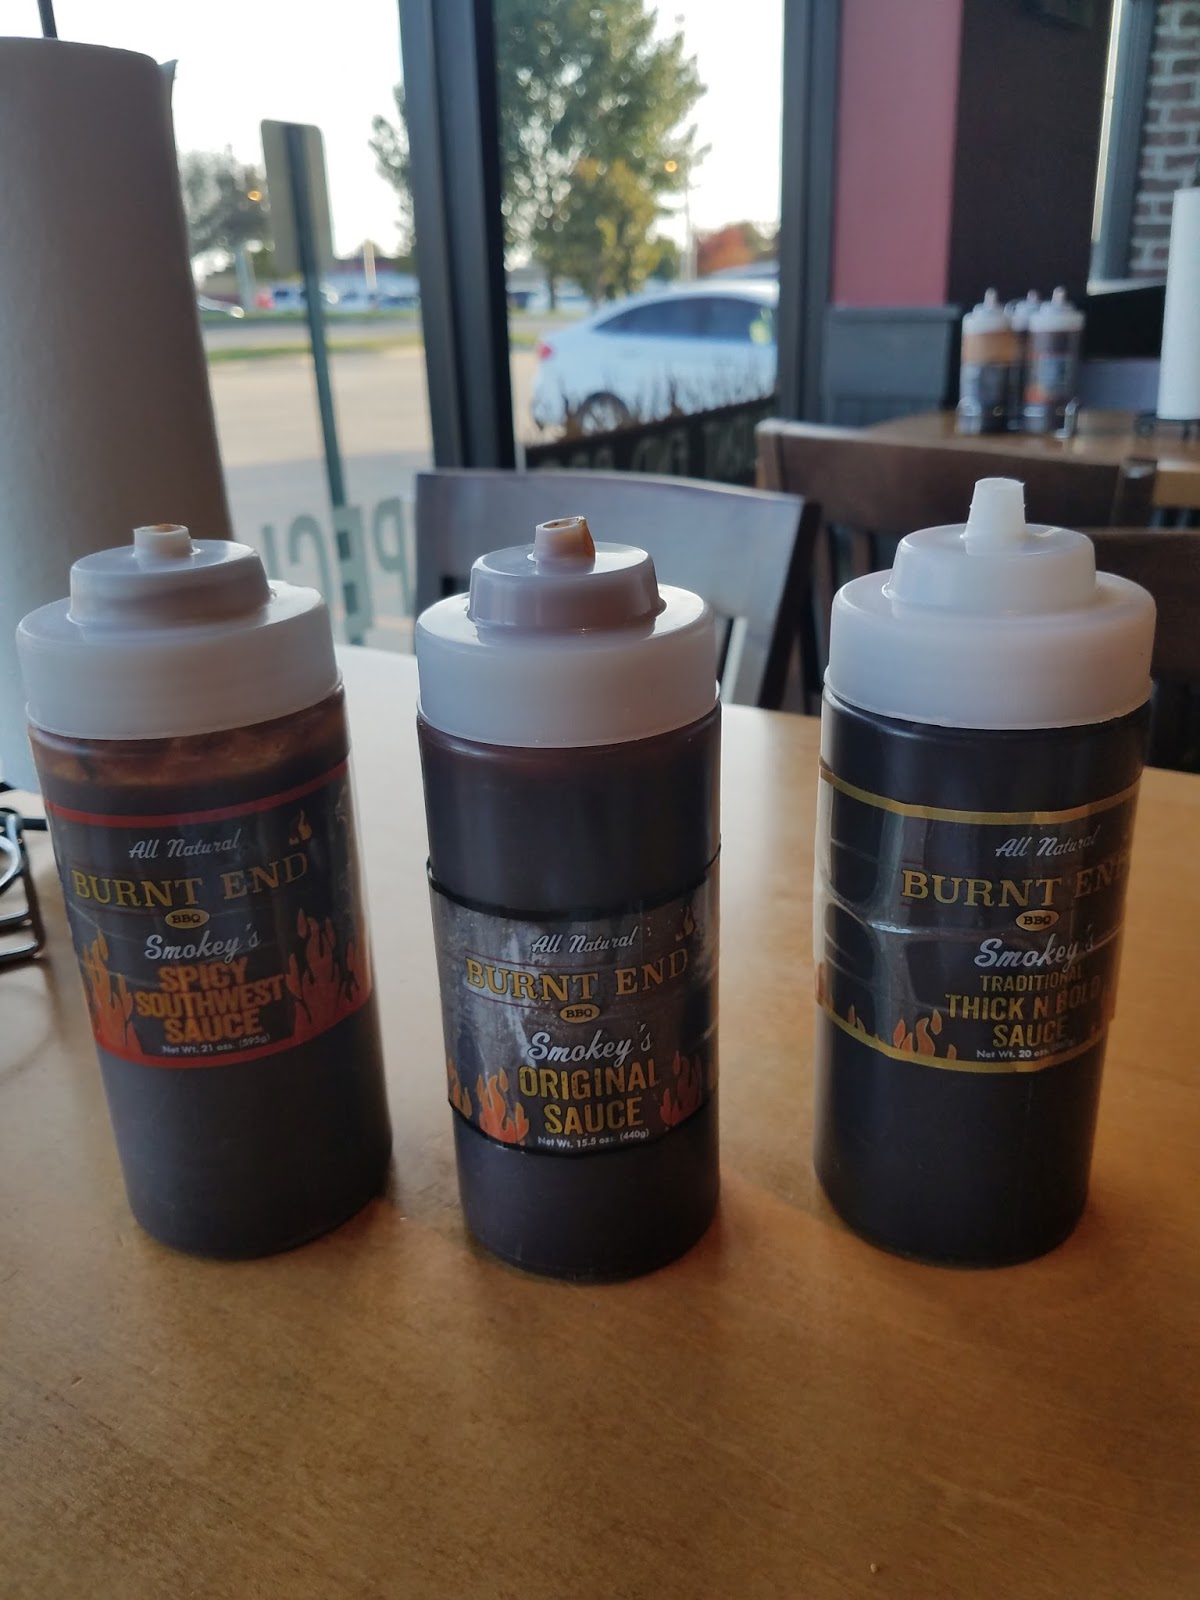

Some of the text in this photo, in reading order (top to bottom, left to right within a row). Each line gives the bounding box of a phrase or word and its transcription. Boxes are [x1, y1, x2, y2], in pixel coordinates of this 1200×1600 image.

[128, 828, 242, 859] All Natural
[994, 824, 1101, 857] All Natural
[71, 852, 308, 907] BURNT END
[901, 869, 1062, 907] BURNT
[171, 913, 201, 925] BBQ
[1023, 915, 1052, 925] BBQ
[144, 923, 262, 963] Smokey's
[531, 926, 639, 953] All Natural
[158, 957, 248, 993] SPICY
[465, 949, 689, 1002] BURNT END
[979, 965, 1083, 992] TRADITIONAL
[134, 974, 285, 1018] SOUTHWEST
[945, 993, 1025, 1021] THICK
[1033, 995, 1048, 1020] N
[164, 1008, 263, 1044] SAUCE
[566, 1008, 592, 1019] BBQ
[528, 1022, 652, 1068] Smokey's
[992, 1015, 1069, 1048] SAUCE
[182, 1045, 198, 1053] Wt.
[202, 1044, 213, 1052] 21
[976, 1050, 995, 1058] Net
[999, 1050, 1016, 1058] Wt.
[1018, 1050, 1032, 1058] 20
[518, 1060, 659, 1100] ORIGINAL
[543, 1096, 644, 1136] SAUCE
[538, 1136, 554, 1146] Net
[557, 1138, 574, 1148] Wt.
[577, 1137, 596, 1148] 15.5
[619, 1128, 649, 1142] (440g)
